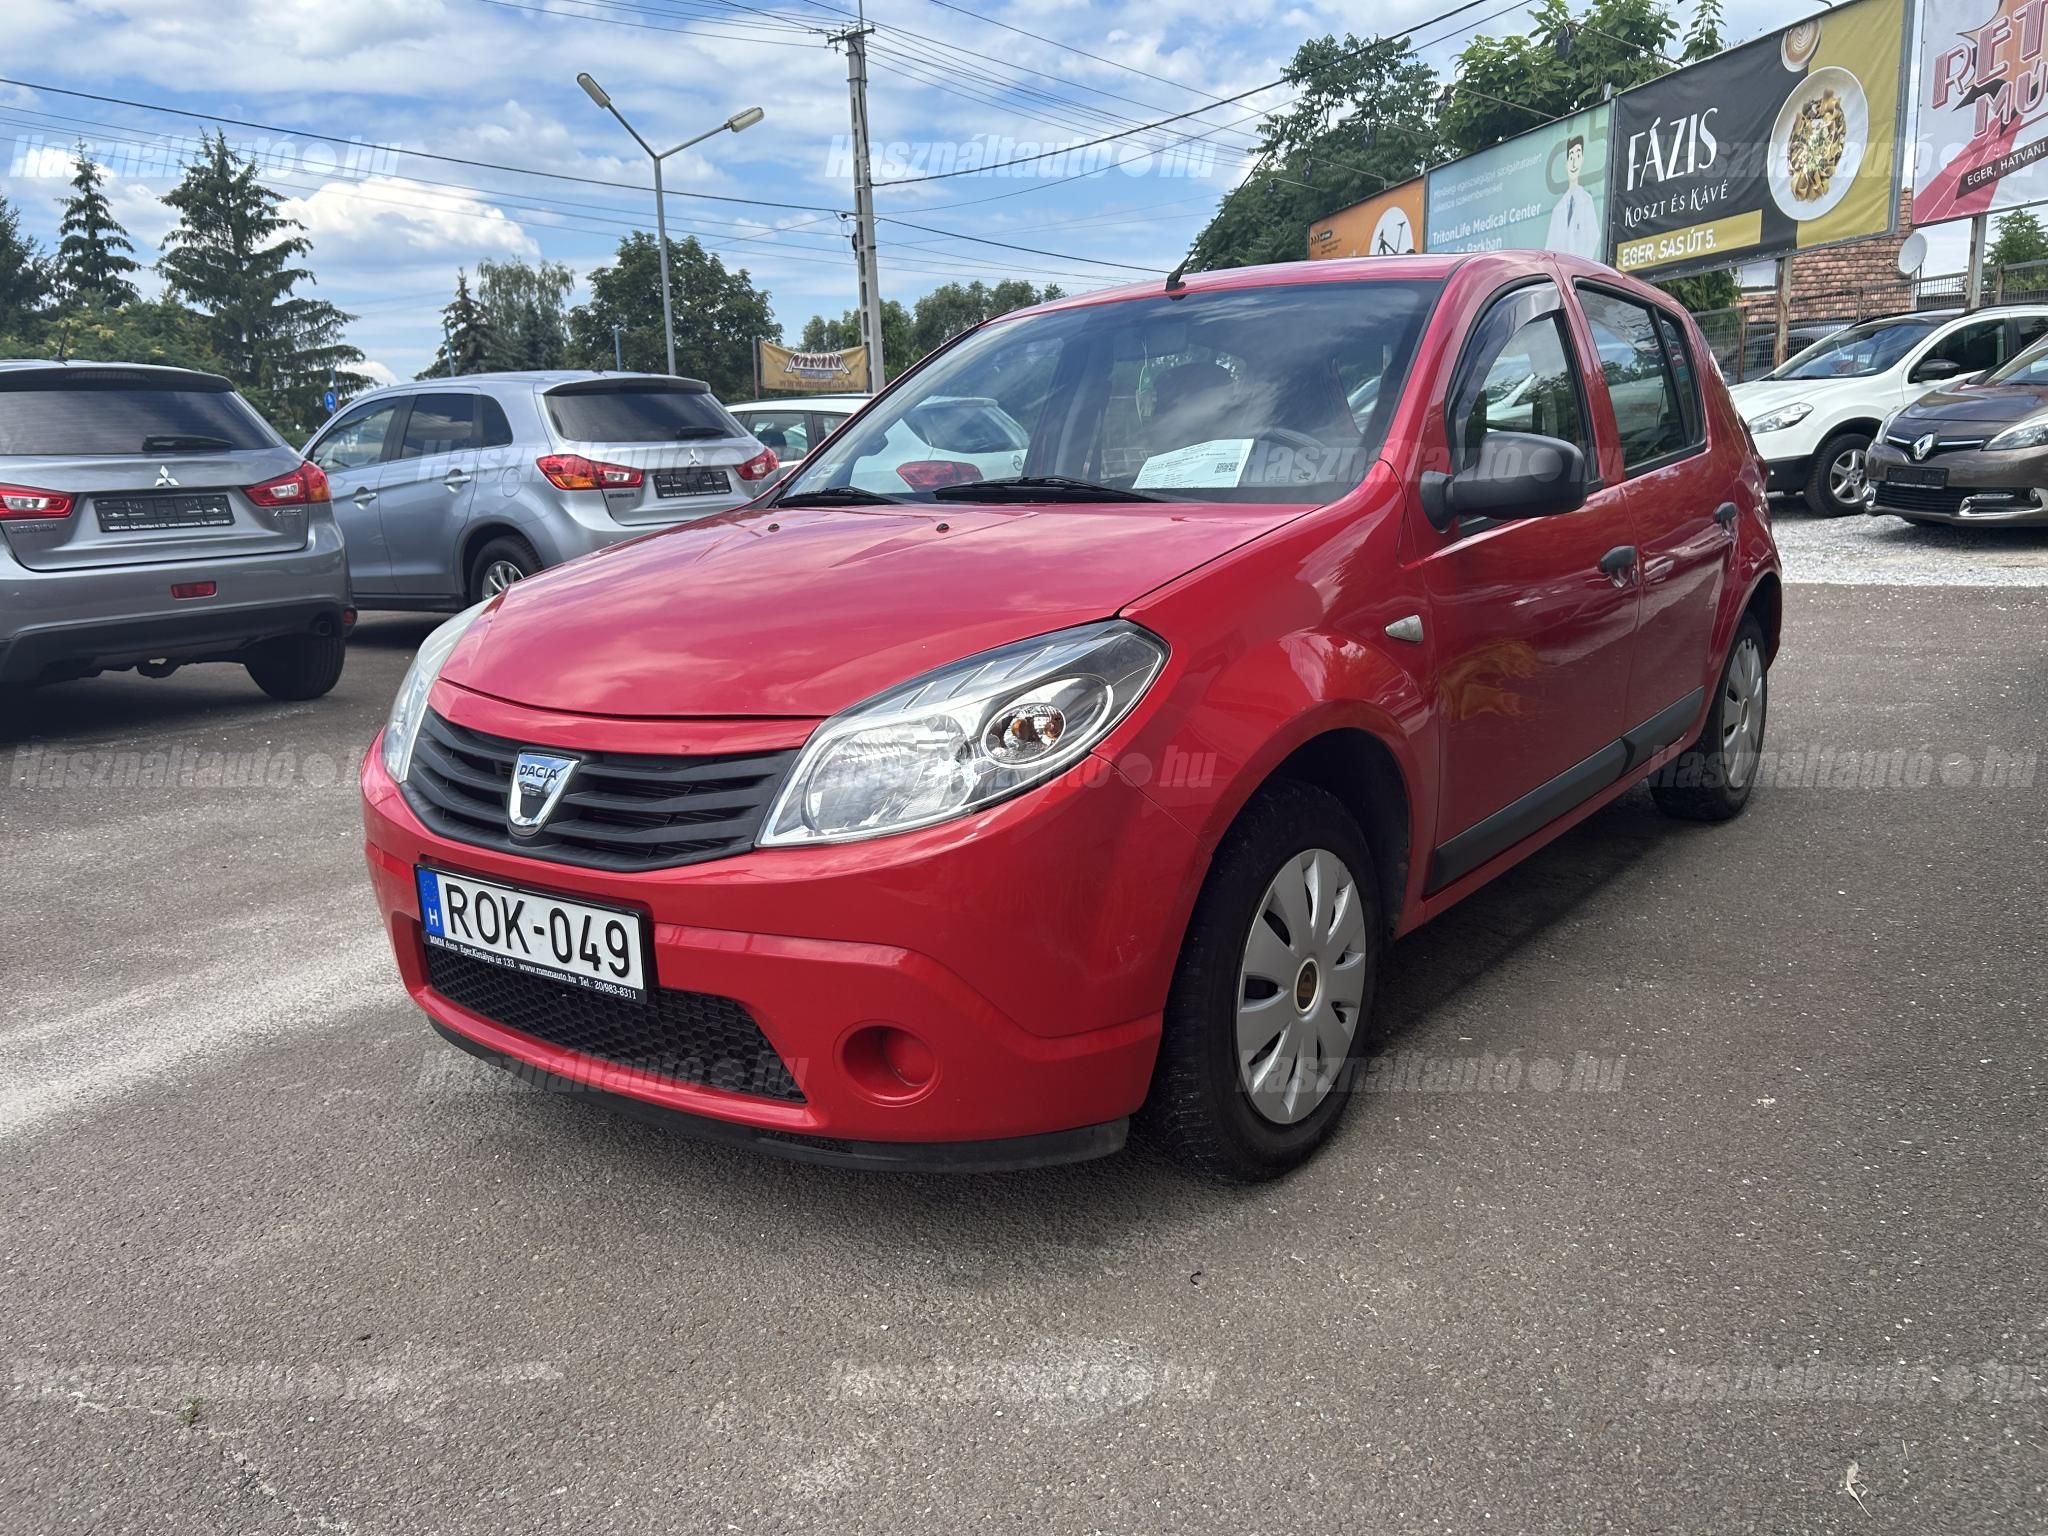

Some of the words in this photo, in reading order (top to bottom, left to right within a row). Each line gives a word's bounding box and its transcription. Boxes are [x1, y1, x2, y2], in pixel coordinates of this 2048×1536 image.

[1627, 107, 1718, 191] FÁZIS
[1967, 167, 1997, 186] EGER,
[2000, 142, 2046, 171] HATVANI
[1433, 223, 1471, 245] TritonLife
[1473, 210, 1507, 233] Medical
[1509, 203, 1541, 223] Center
[1625, 200, 1666, 228] KOSZT
[1671, 194, 1685, 213] ÉS
[1691, 179, 1729, 211] KÁVÉ
[1622, 243, 1656, 266] EGER,
[1658, 234, 1684, 259] SAS
[1687, 227, 1704, 253] ÚT
[1706, 229, 1717, 248] 5.
[520, 764, 557, 780] DACIA
[428, 907, 439, 927] H
[446, 883, 630, 978] ROK-049
[503, 957, 517, 968] 133.
[519, 963, 576, 984] www.mmmauto.hu
[579, 976, 593, 989] Tel.:
[594, 980, 637, 999] 20/983-8311
